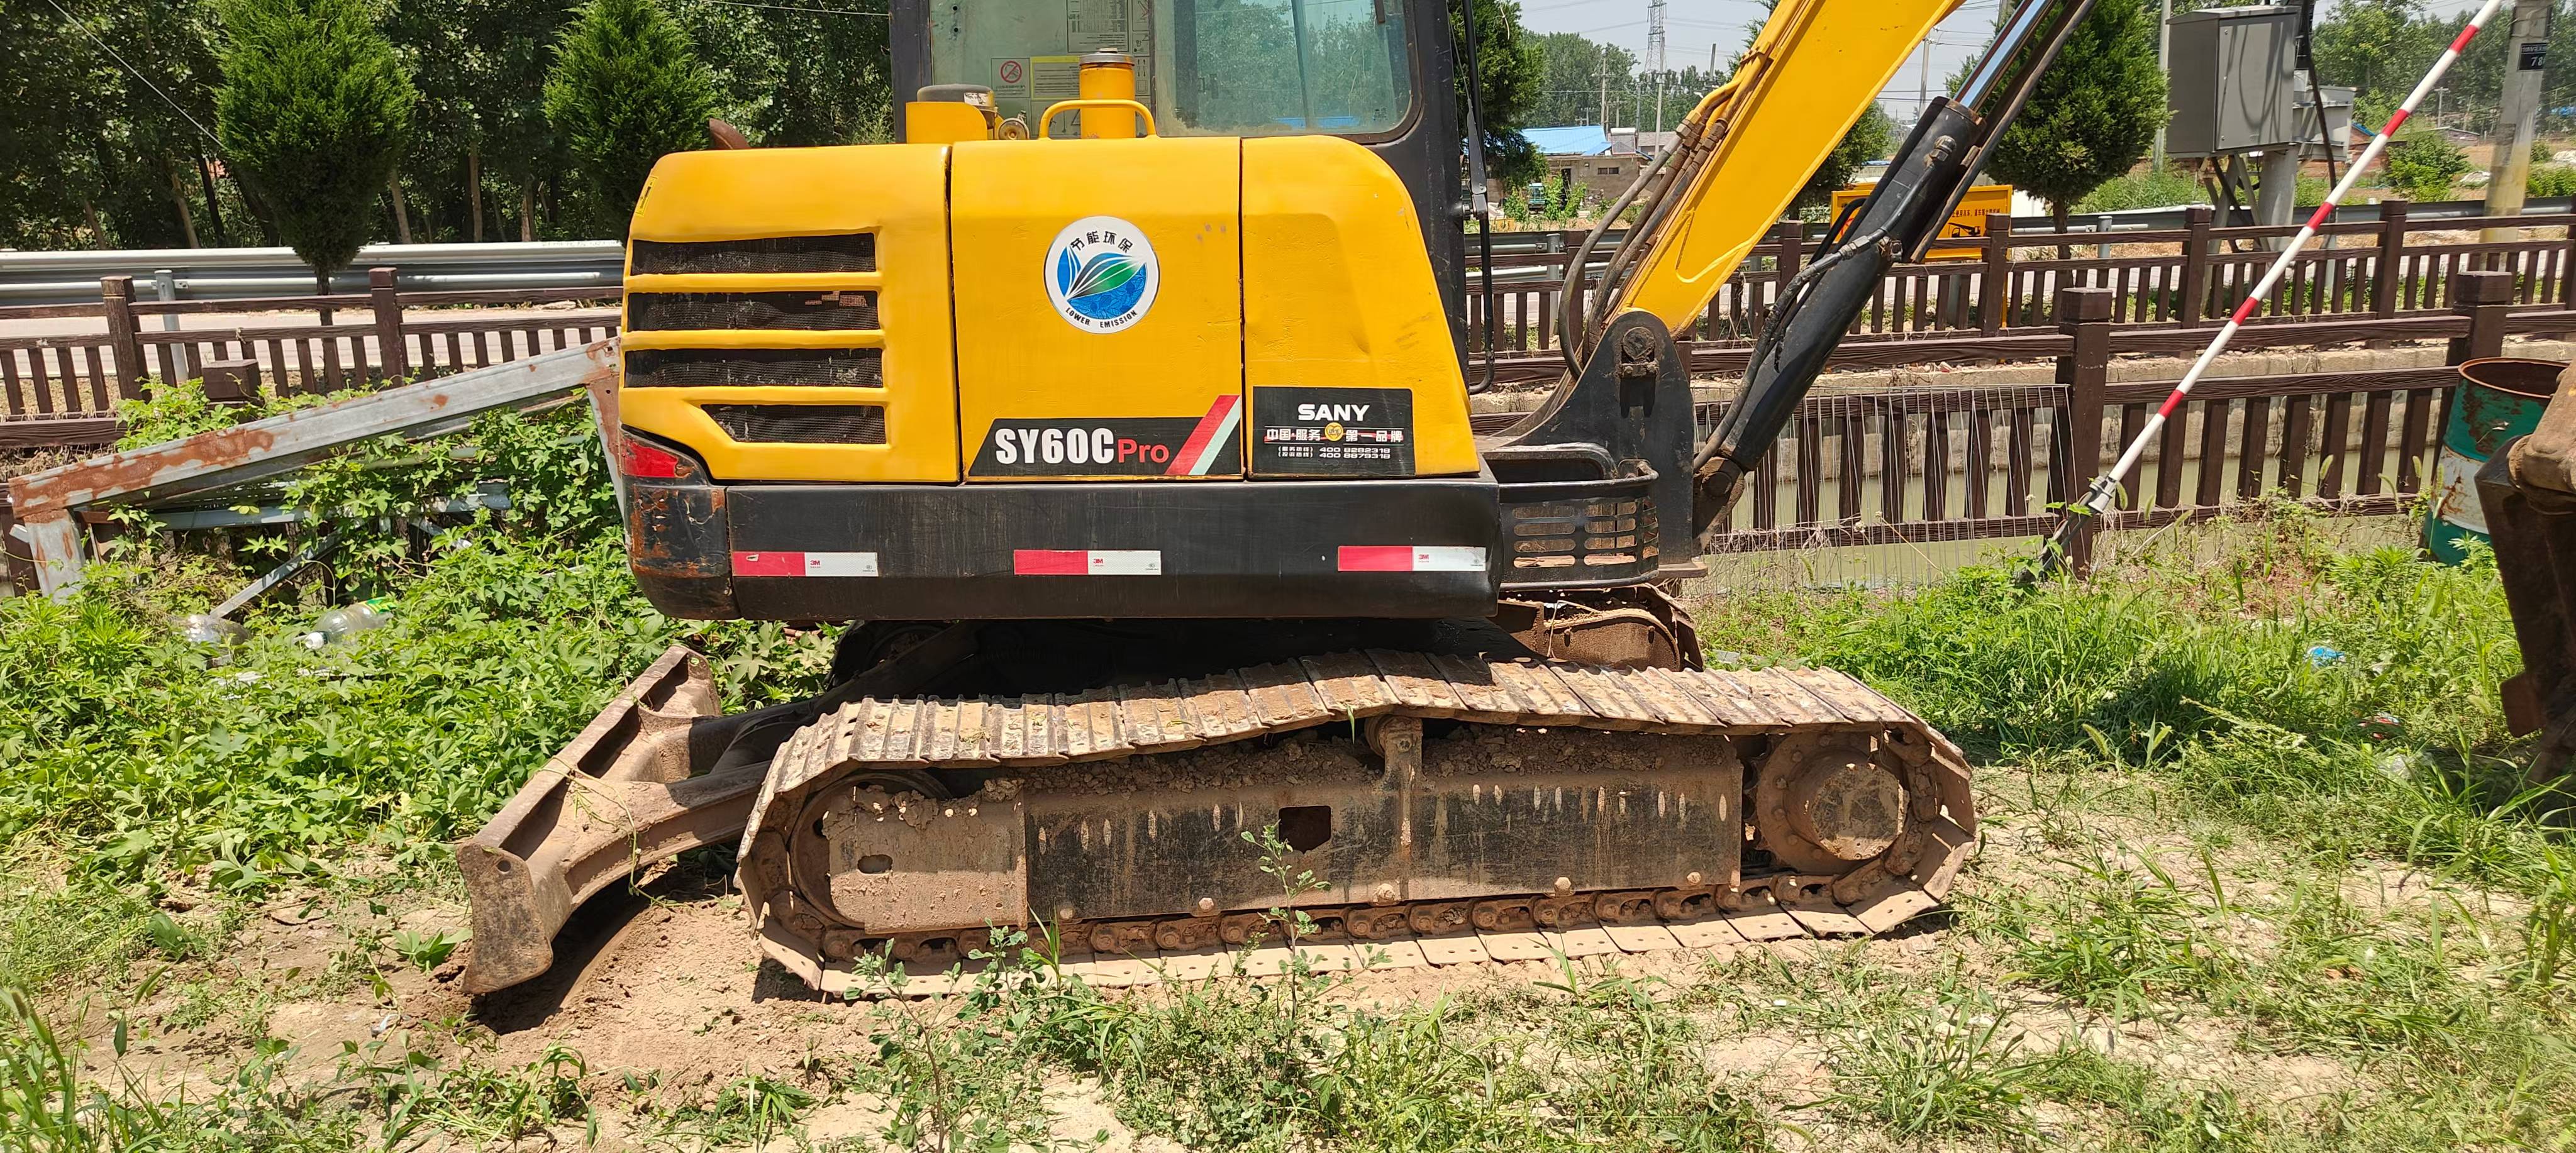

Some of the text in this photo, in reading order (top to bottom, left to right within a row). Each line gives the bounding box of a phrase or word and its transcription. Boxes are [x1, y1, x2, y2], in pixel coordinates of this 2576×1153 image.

[1070, 230, 1134, 254] 节能环保
[1065, 307, 1138, 329] LOWER EMISSION
[1298, 404, 1370, 421] SANY
[994, 428, 1170, 465] SY60C Pro
[1345, 429, 1402, 443] 第一品牌
